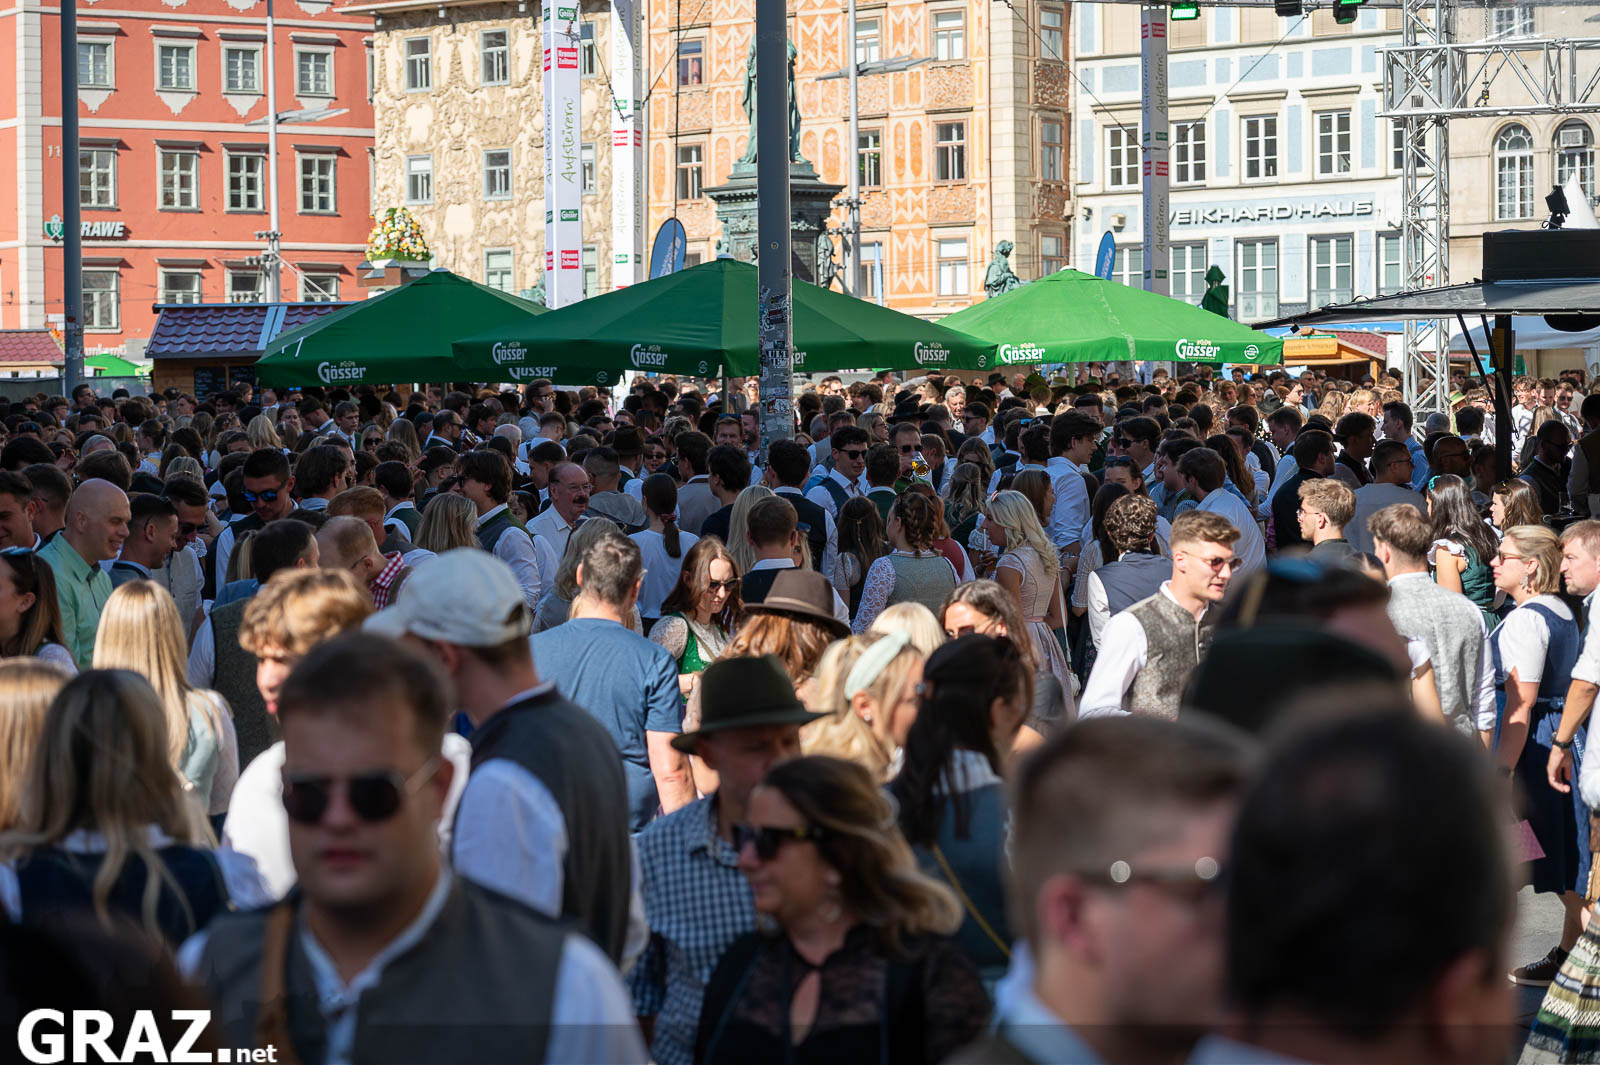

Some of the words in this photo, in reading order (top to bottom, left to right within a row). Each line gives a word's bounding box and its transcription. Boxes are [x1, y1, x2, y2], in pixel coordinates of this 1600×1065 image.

[47, 145, 60, 158] 11
[561, 99, 577, 184] Aufsteirern
[80, 221, 125, 237] RAWE
[492, 341, 528, 365] Gösser
[630, 343, 668, 368] Gösser
[913, 341, 950, 365] Gösser
[1000, 344, 1046, 364] Gösser
[1175, 339, 1221, 360] Gösser
[318, 361, 367, 384] Gösser
